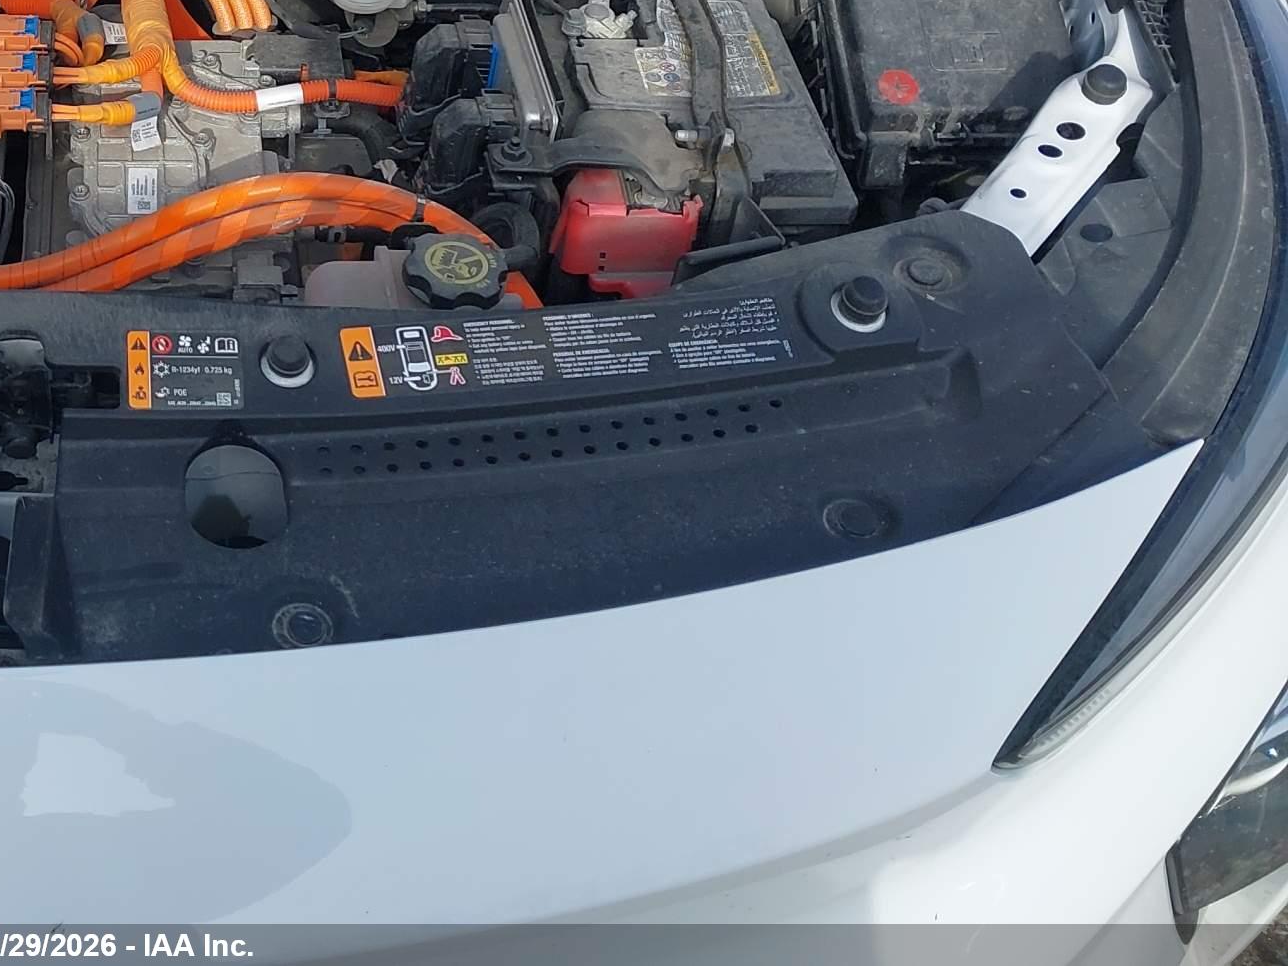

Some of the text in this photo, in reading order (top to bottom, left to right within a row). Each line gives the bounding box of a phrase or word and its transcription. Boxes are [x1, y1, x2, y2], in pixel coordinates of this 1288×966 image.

[377, 345, 396, 353] 400V
[389, 376, 405, 385] 12V
[174, 388, 187, 396] POE
